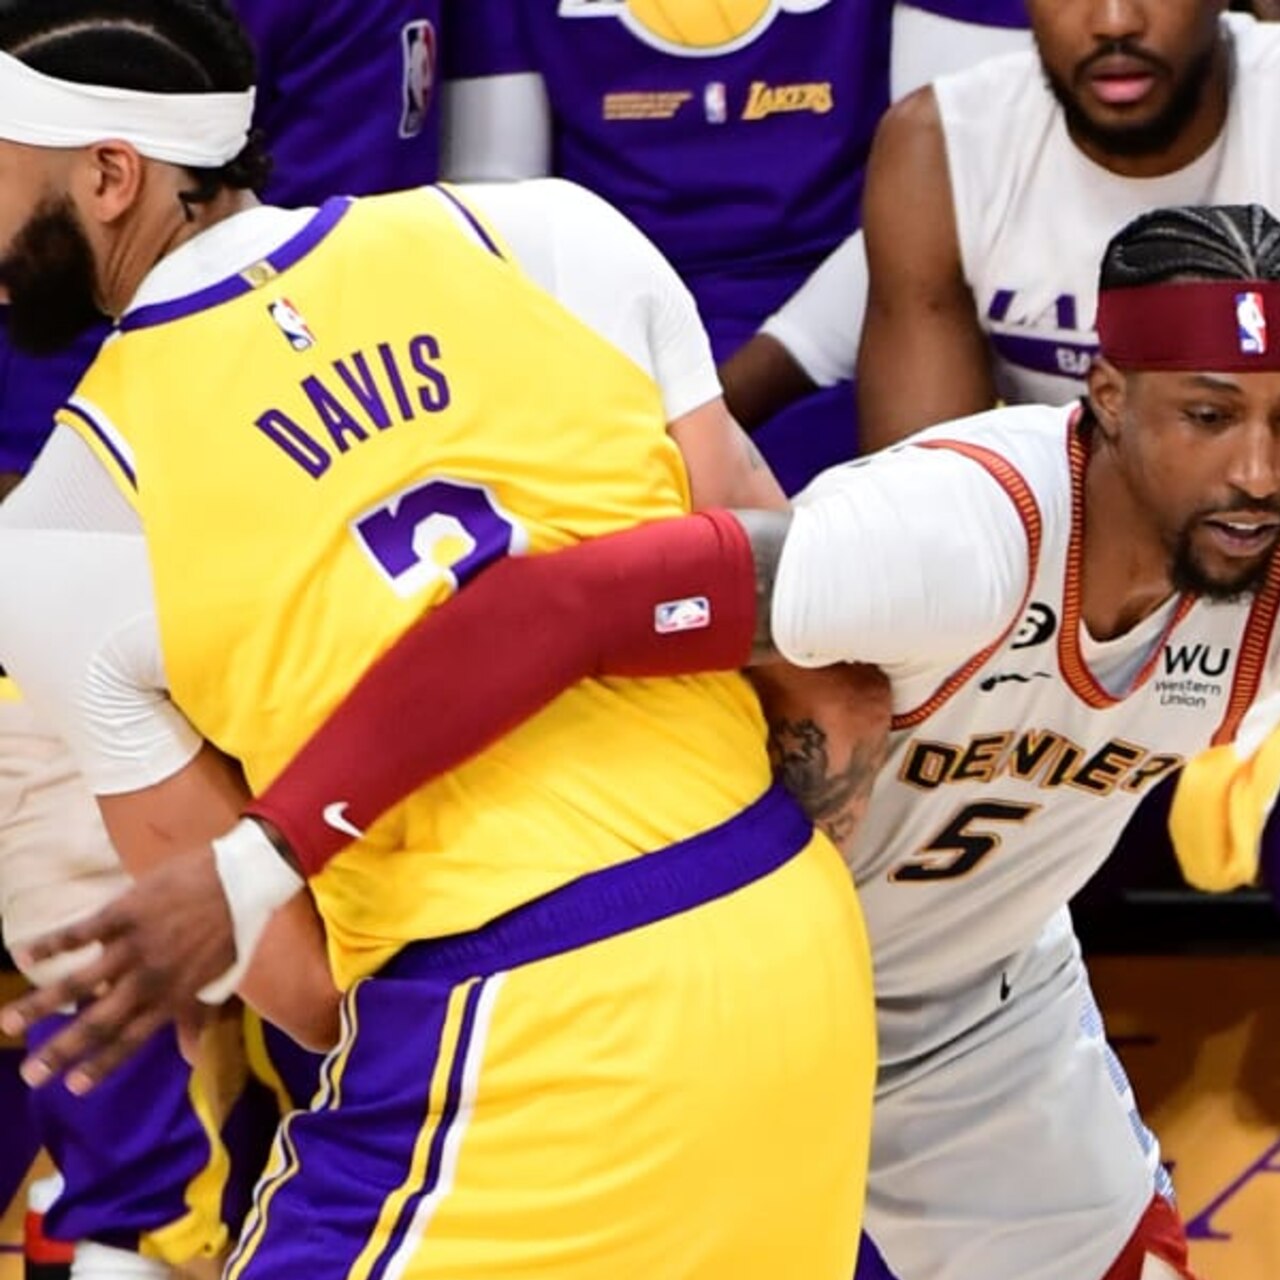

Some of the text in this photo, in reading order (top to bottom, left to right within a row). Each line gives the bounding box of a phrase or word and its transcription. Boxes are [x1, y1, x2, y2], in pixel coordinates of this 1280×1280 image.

[254, 334, 450, 480] DAVIS
[1162, 643, 1232, 677] WU
[1154, 678, 1222, 697] Western
[1159, 692, 1207, 709] Union
[887, 798, 1044, 884] 5
